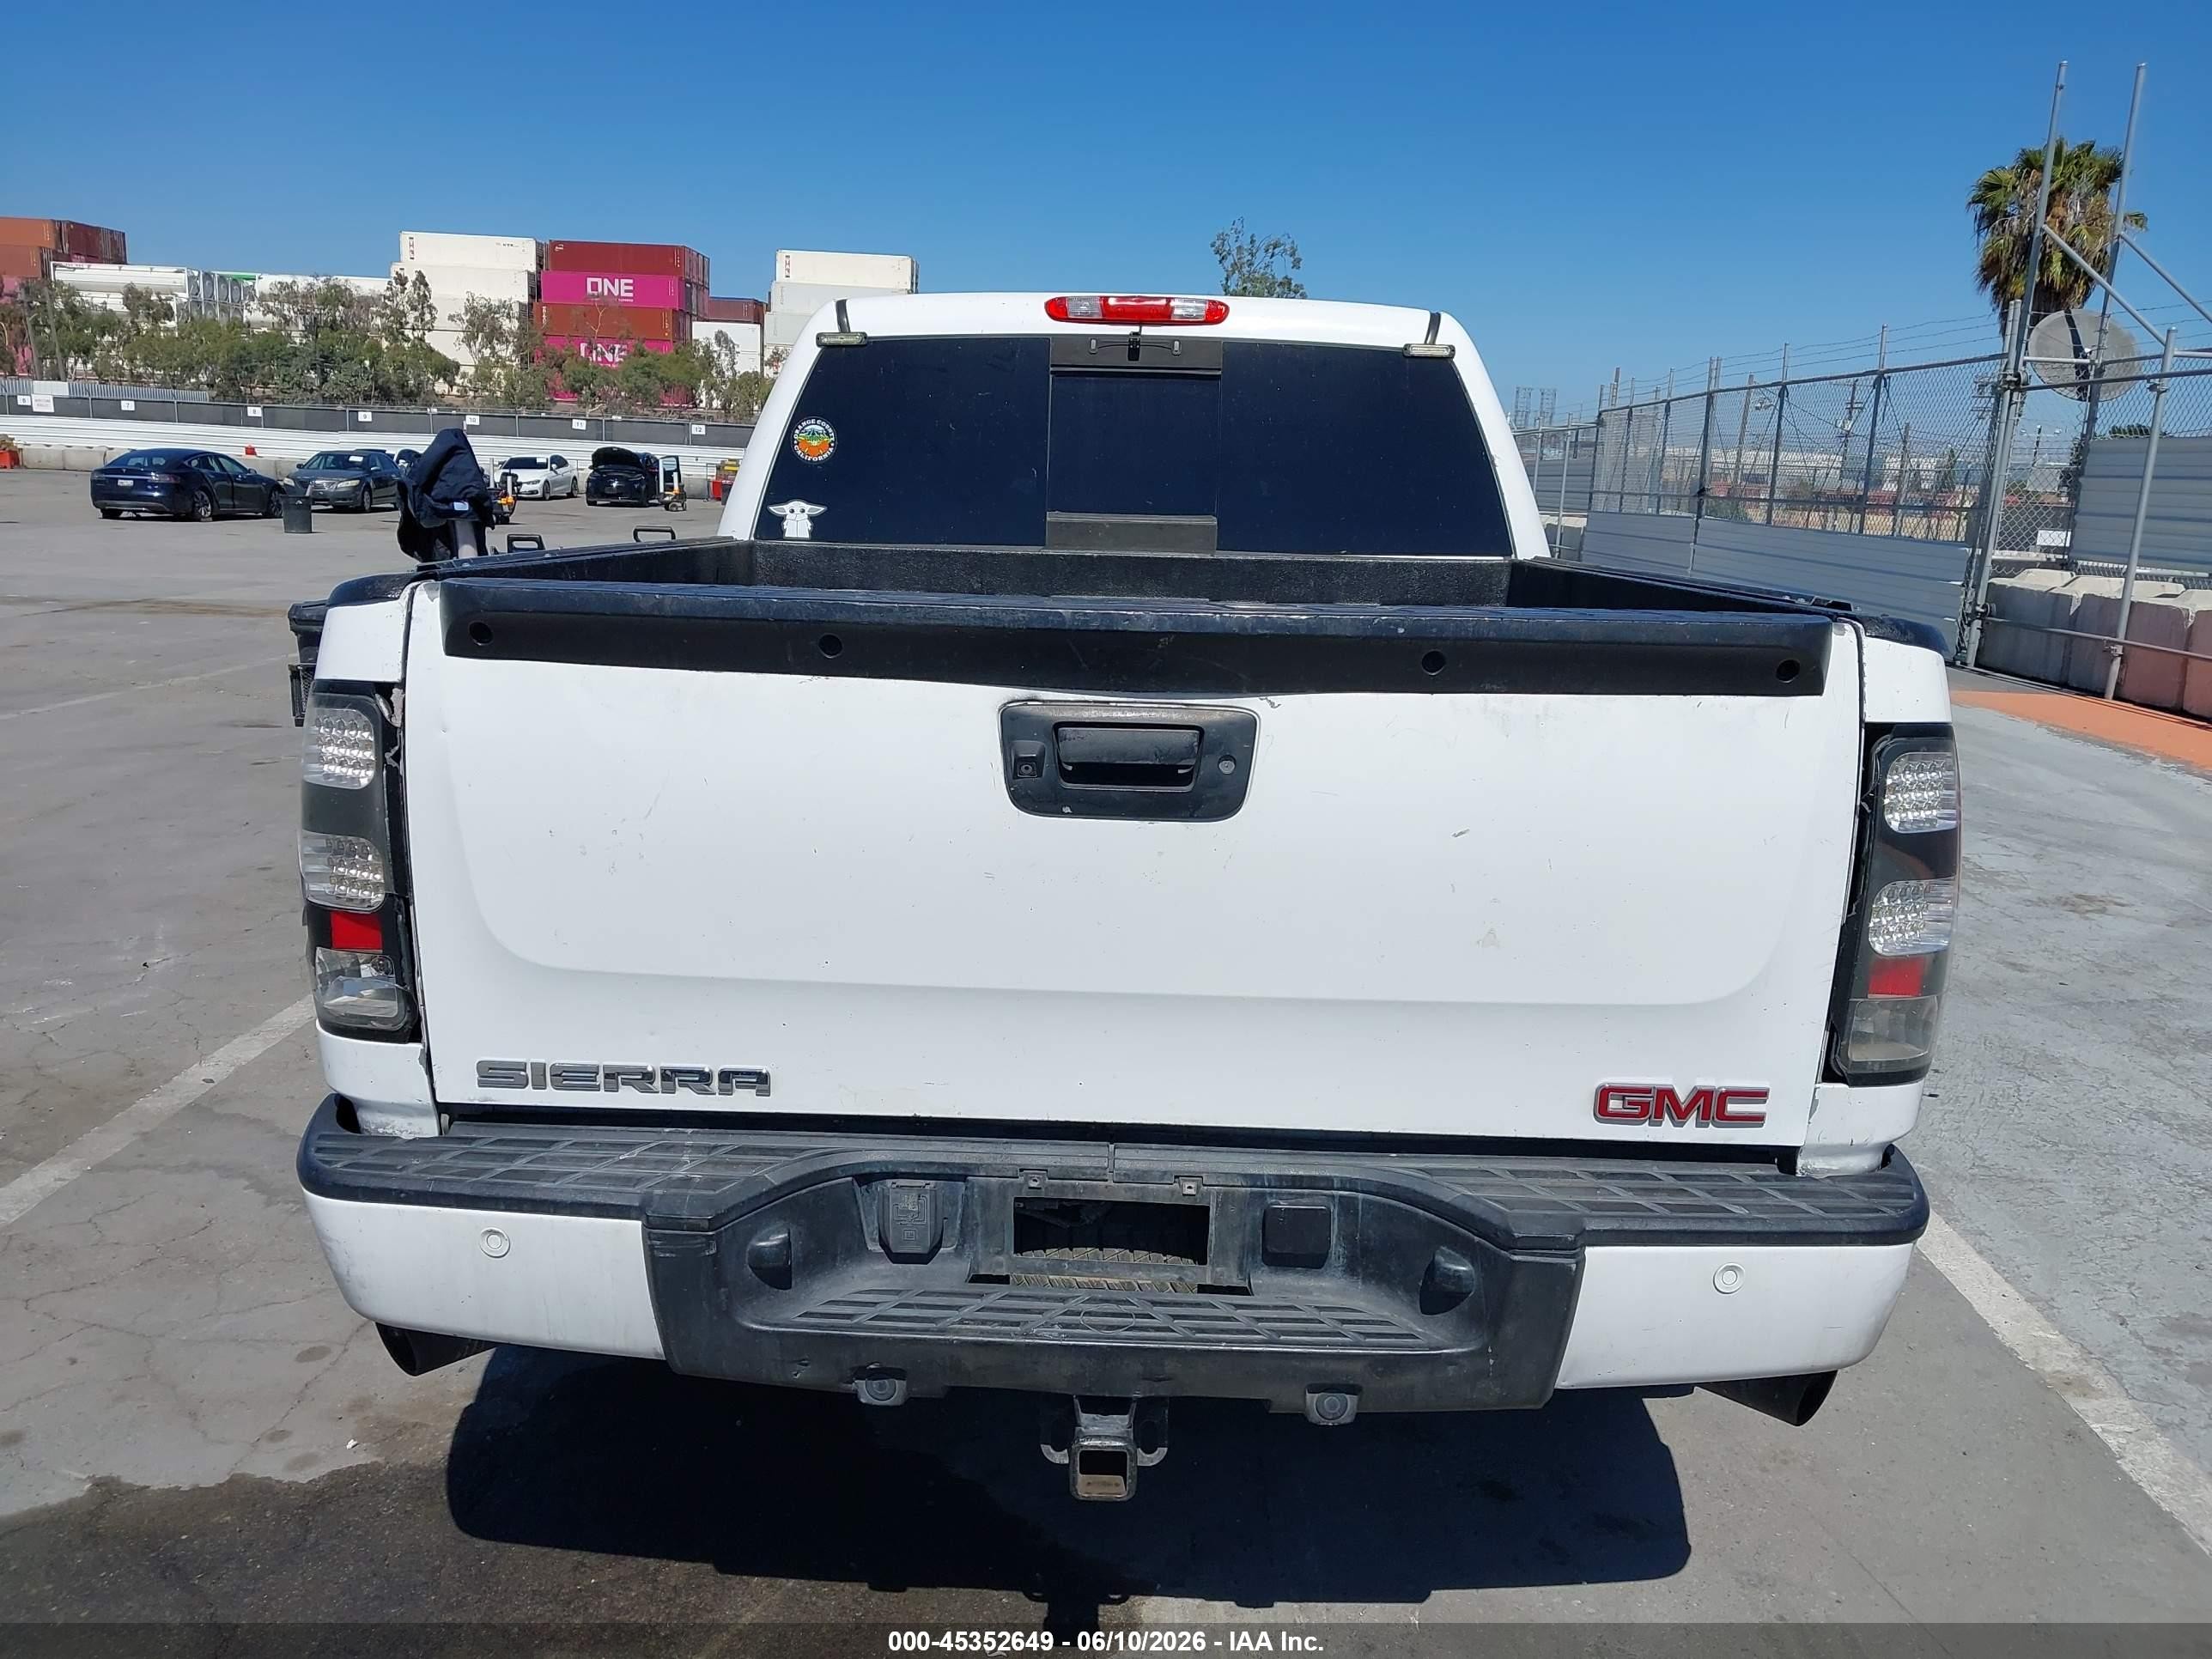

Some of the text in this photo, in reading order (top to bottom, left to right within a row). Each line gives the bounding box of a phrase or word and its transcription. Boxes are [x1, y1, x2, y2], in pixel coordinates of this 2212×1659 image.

[586, 277, 634, 297] ONE
[794, 419, 835, 441] ORANGE COUNTY
[794, 445, 834, 461] CALIFORNIA
[477, 1059, 772, 1097] SIERRA
[1593, 1083, 1771, 1128] GMC
